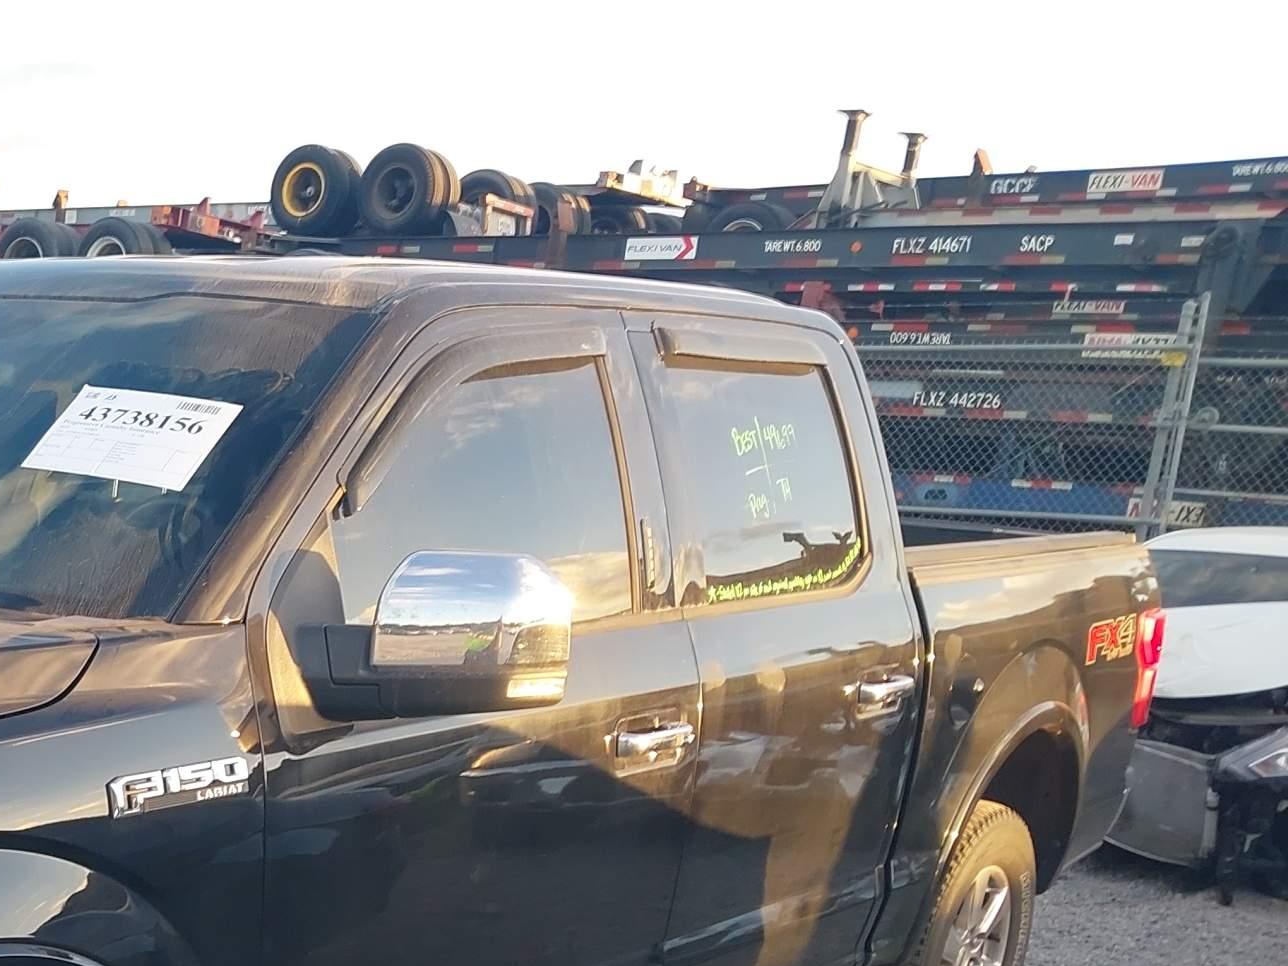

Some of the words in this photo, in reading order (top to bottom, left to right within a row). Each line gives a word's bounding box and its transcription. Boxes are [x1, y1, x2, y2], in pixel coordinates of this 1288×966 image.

[1089, 170, 1160, 191] FLEXI-VAN
[892, 237, 927, 254] FLXZ
[928, 235, 972, 253] 414671
[1020, 234, 1055, 252] SACP
[912, 391, 946, 407] FLXZ
[947, 392, 1002, 409] 442726
[78, 405, 208, 435] 43738156
[1085, 613, 1137, 666] FX4
[196, 782, 245, 801] LARIAT
